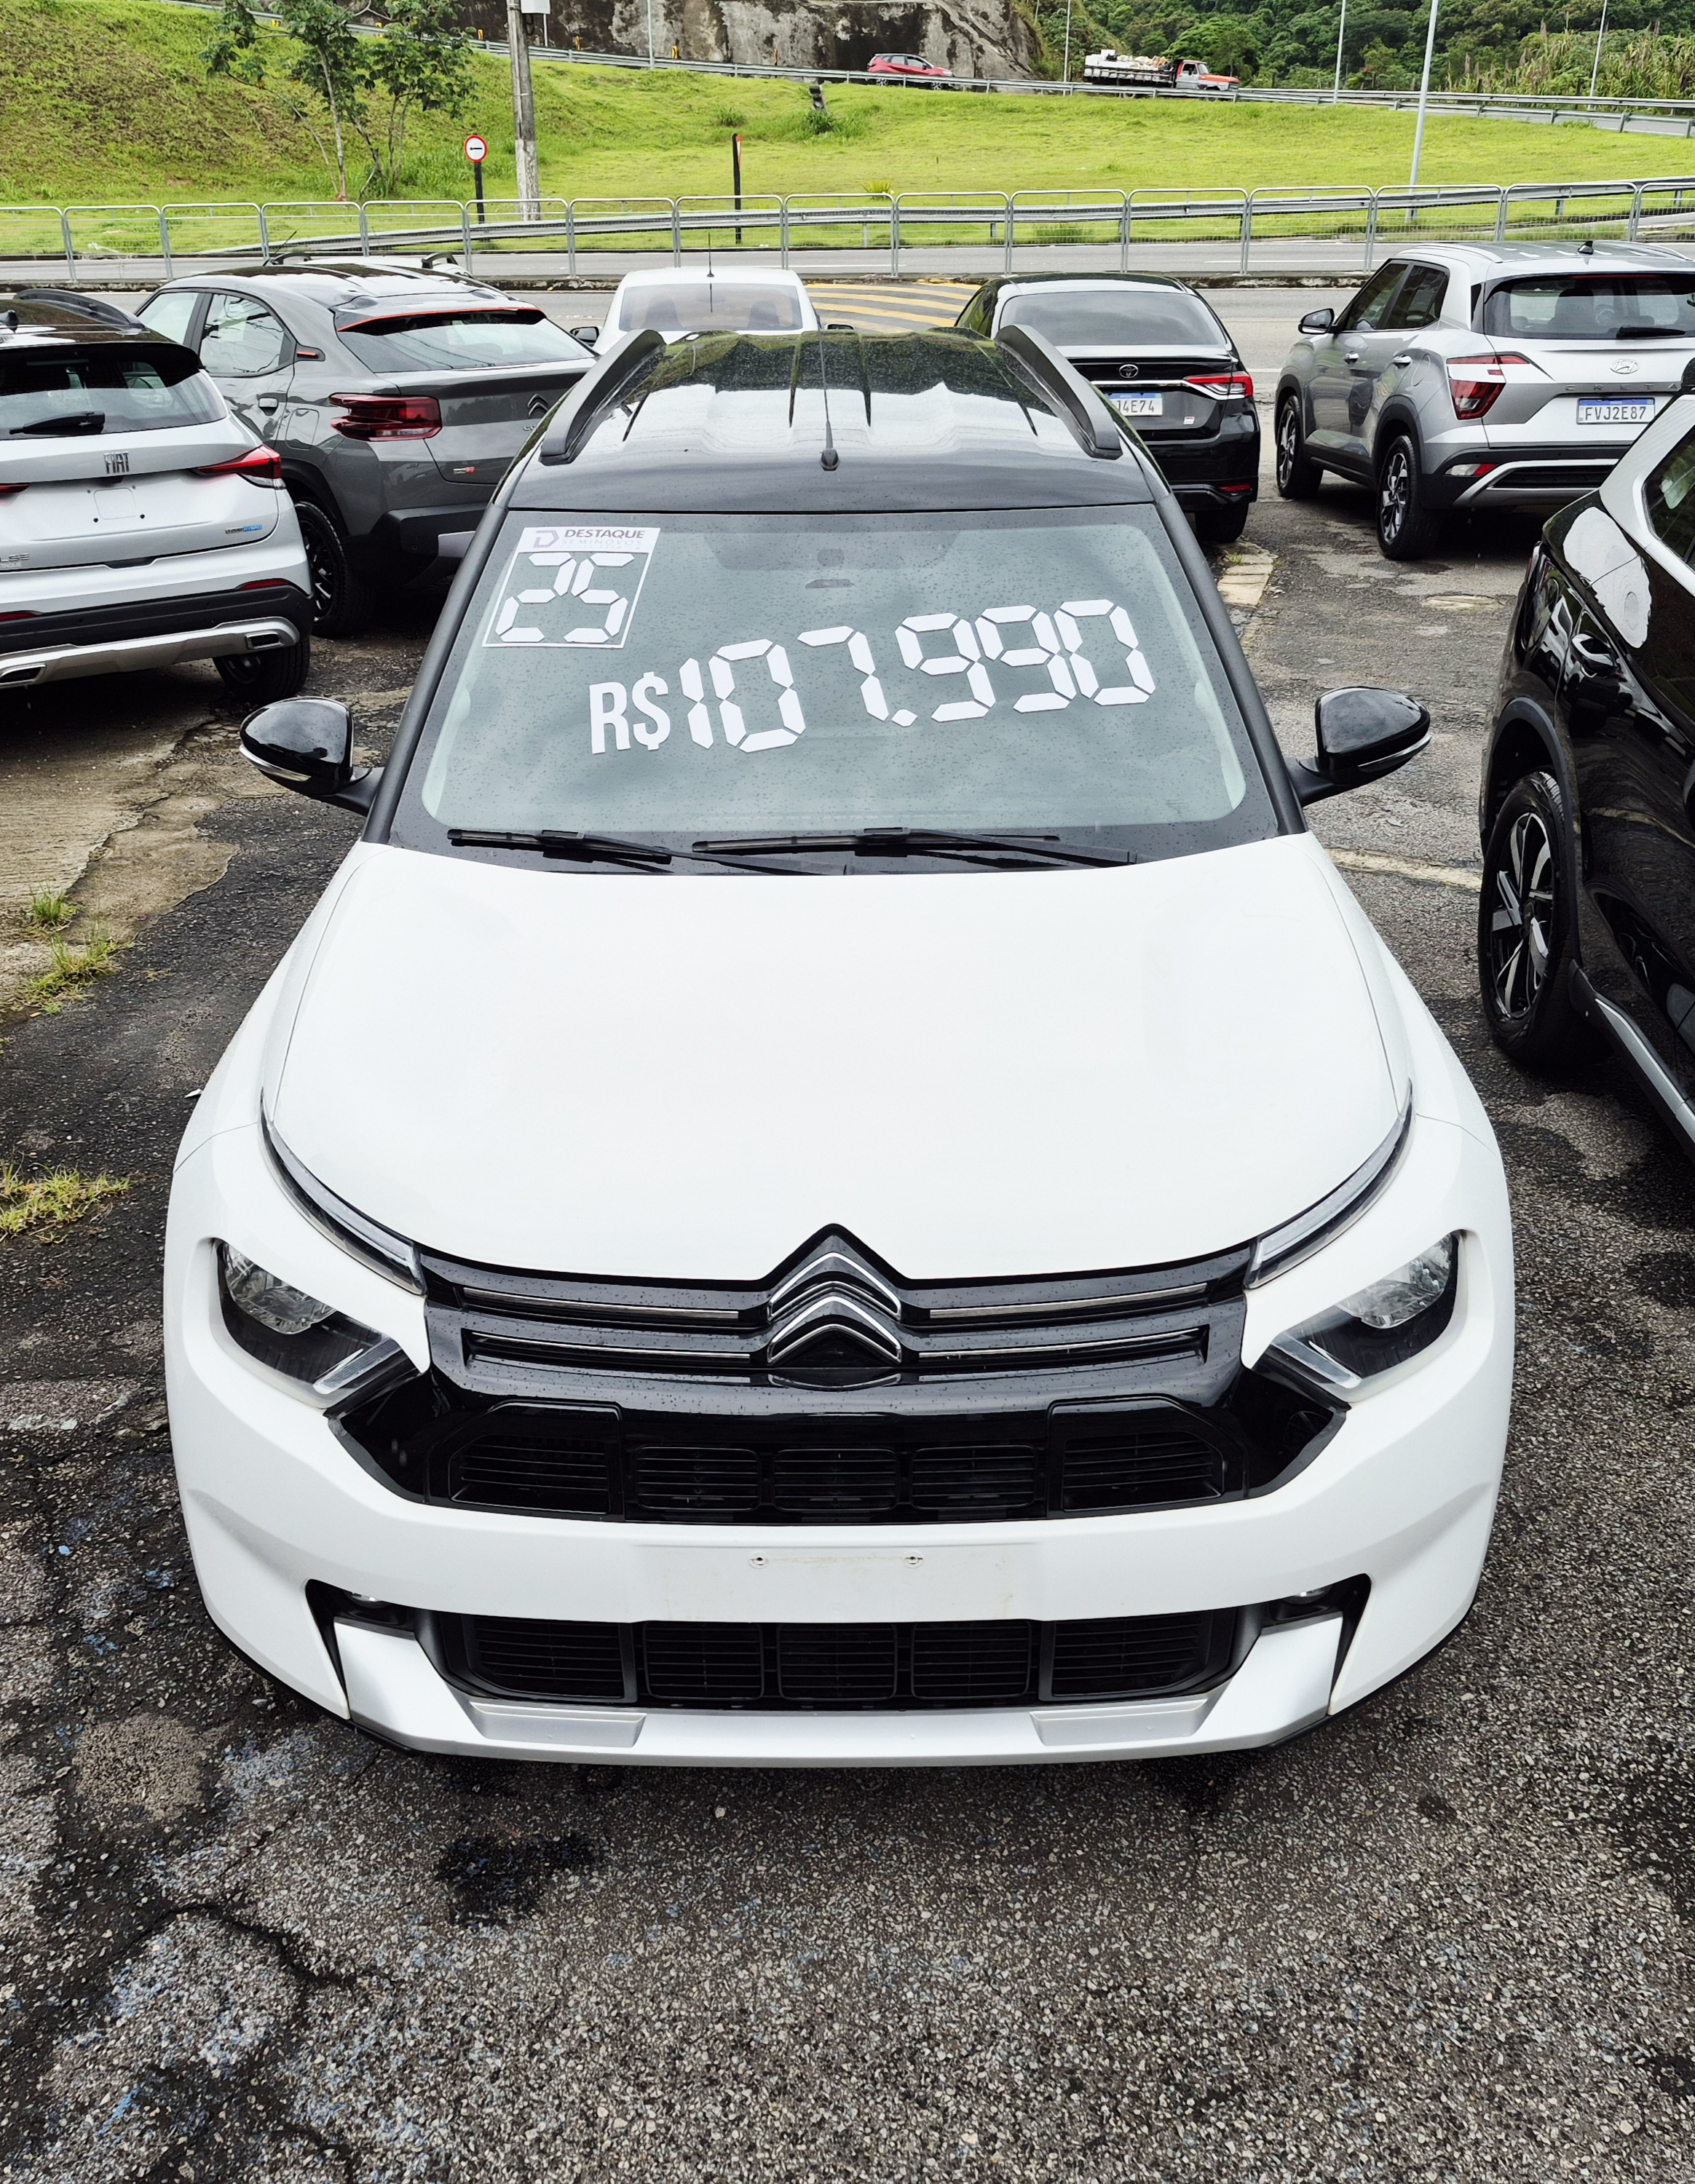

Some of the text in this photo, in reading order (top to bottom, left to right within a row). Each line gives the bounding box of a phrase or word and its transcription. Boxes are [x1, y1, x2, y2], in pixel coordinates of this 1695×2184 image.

[1566, 383, 1678, 391] CRETA
[1111, 400, 1155, 414] J4E74
[1585, 406, 1647, 421] FVJ2E87
[104, 451, 130, 474] FIAT
[564, 529, 646, 539] DESTAQUE
[495, 552, 635, 644] 25
